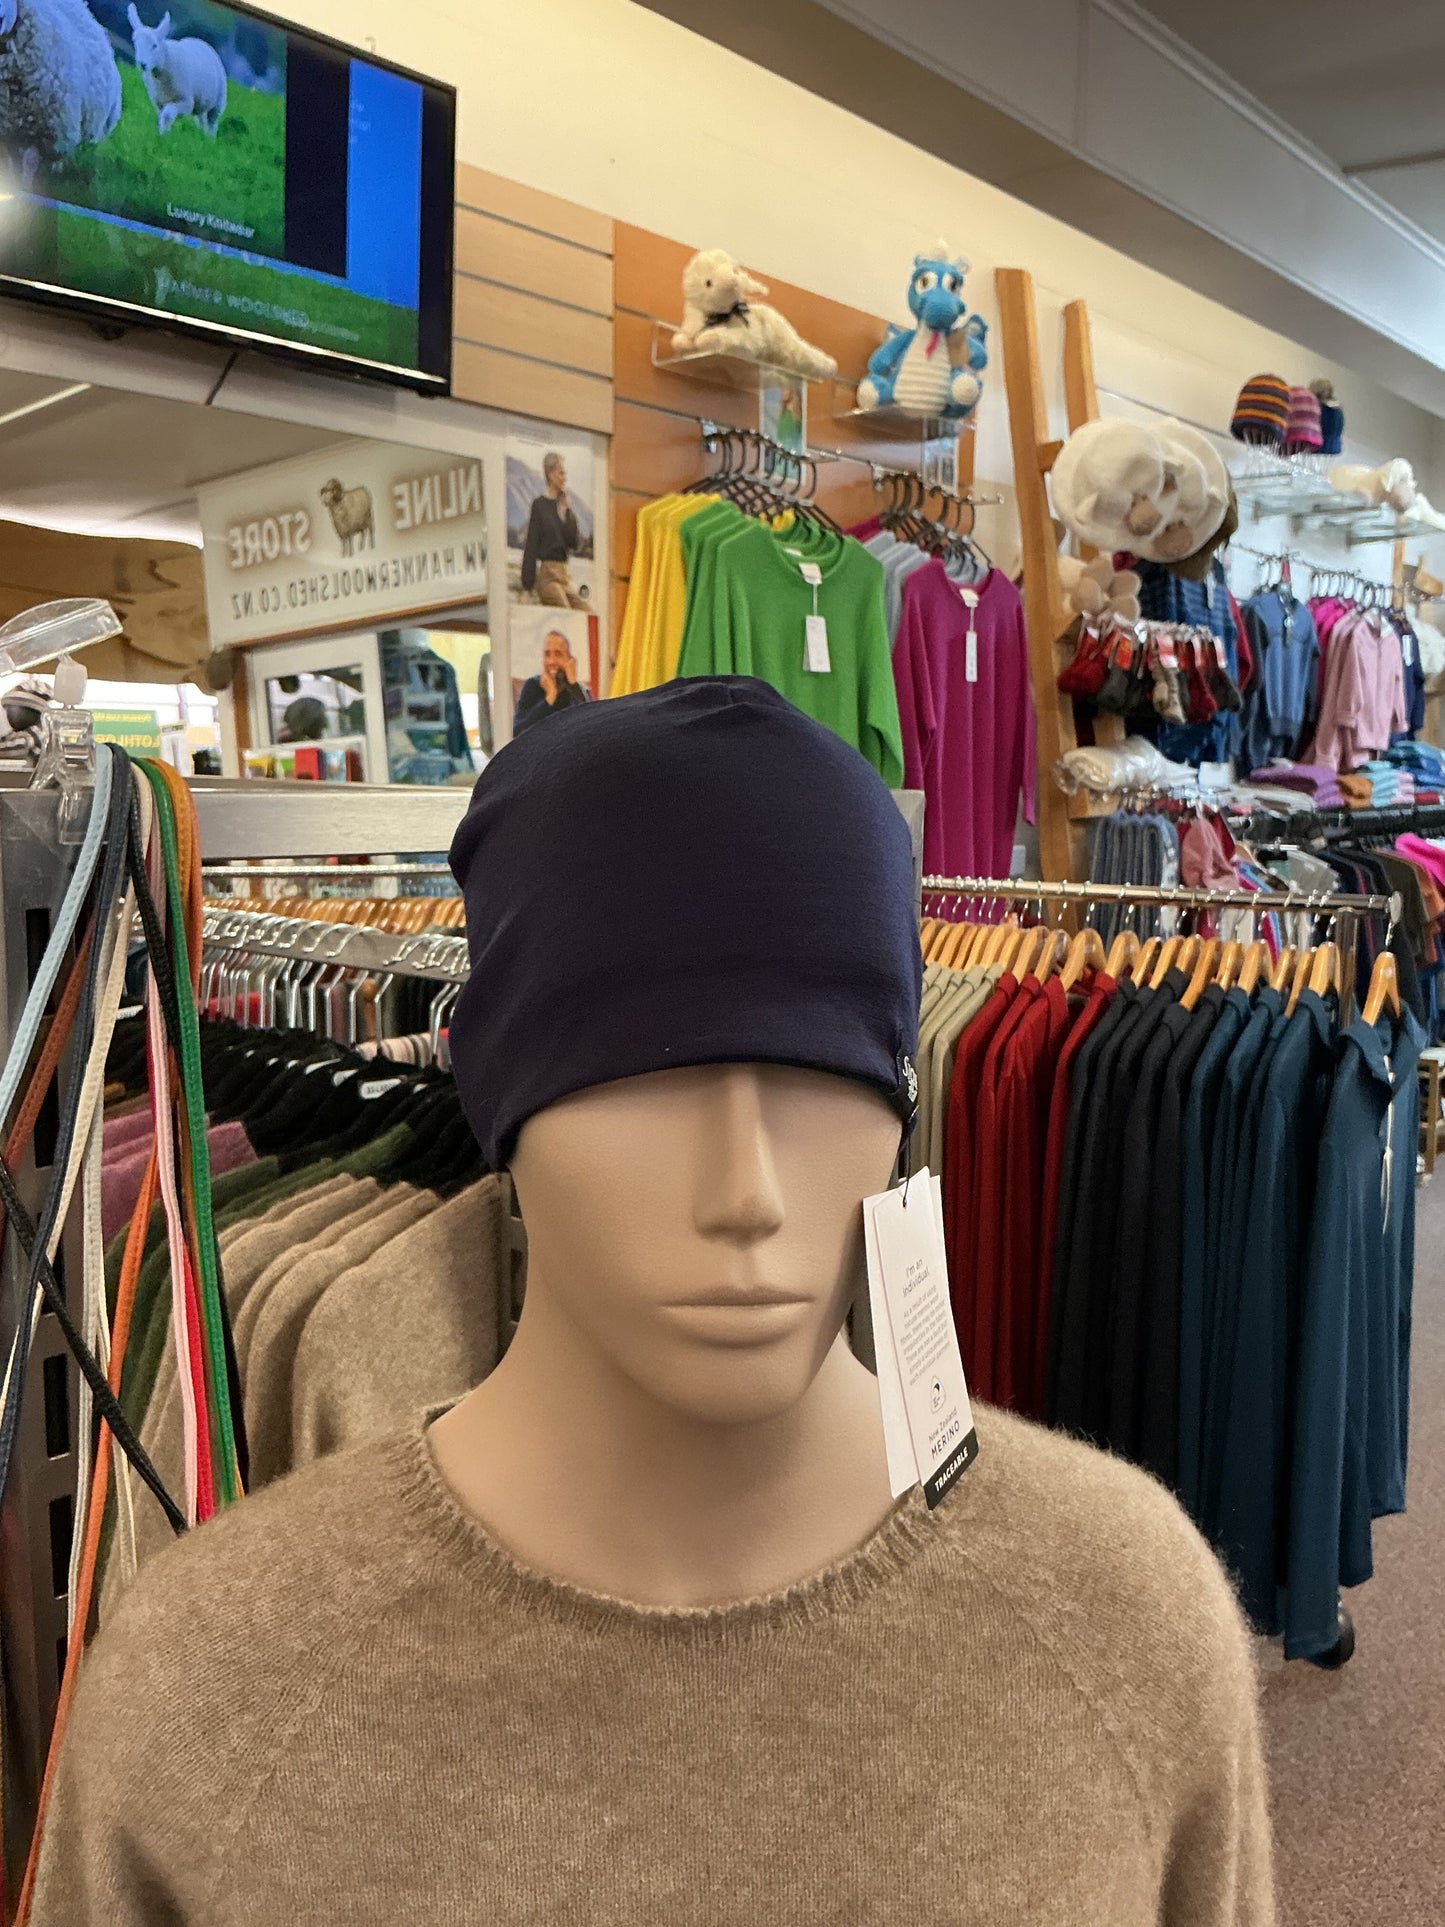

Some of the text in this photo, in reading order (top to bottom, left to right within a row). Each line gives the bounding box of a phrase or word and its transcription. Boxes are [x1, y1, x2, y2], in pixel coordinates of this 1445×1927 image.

[166, 202, 207, 227] Luxury
[905, 1258, 923, 1279] I'm an
[928, 1406, 957, 1443] New Zealand
[931, 1420, 960, 1460] MERINO
[934, 1446, 969, 1492] TRACEABLE
